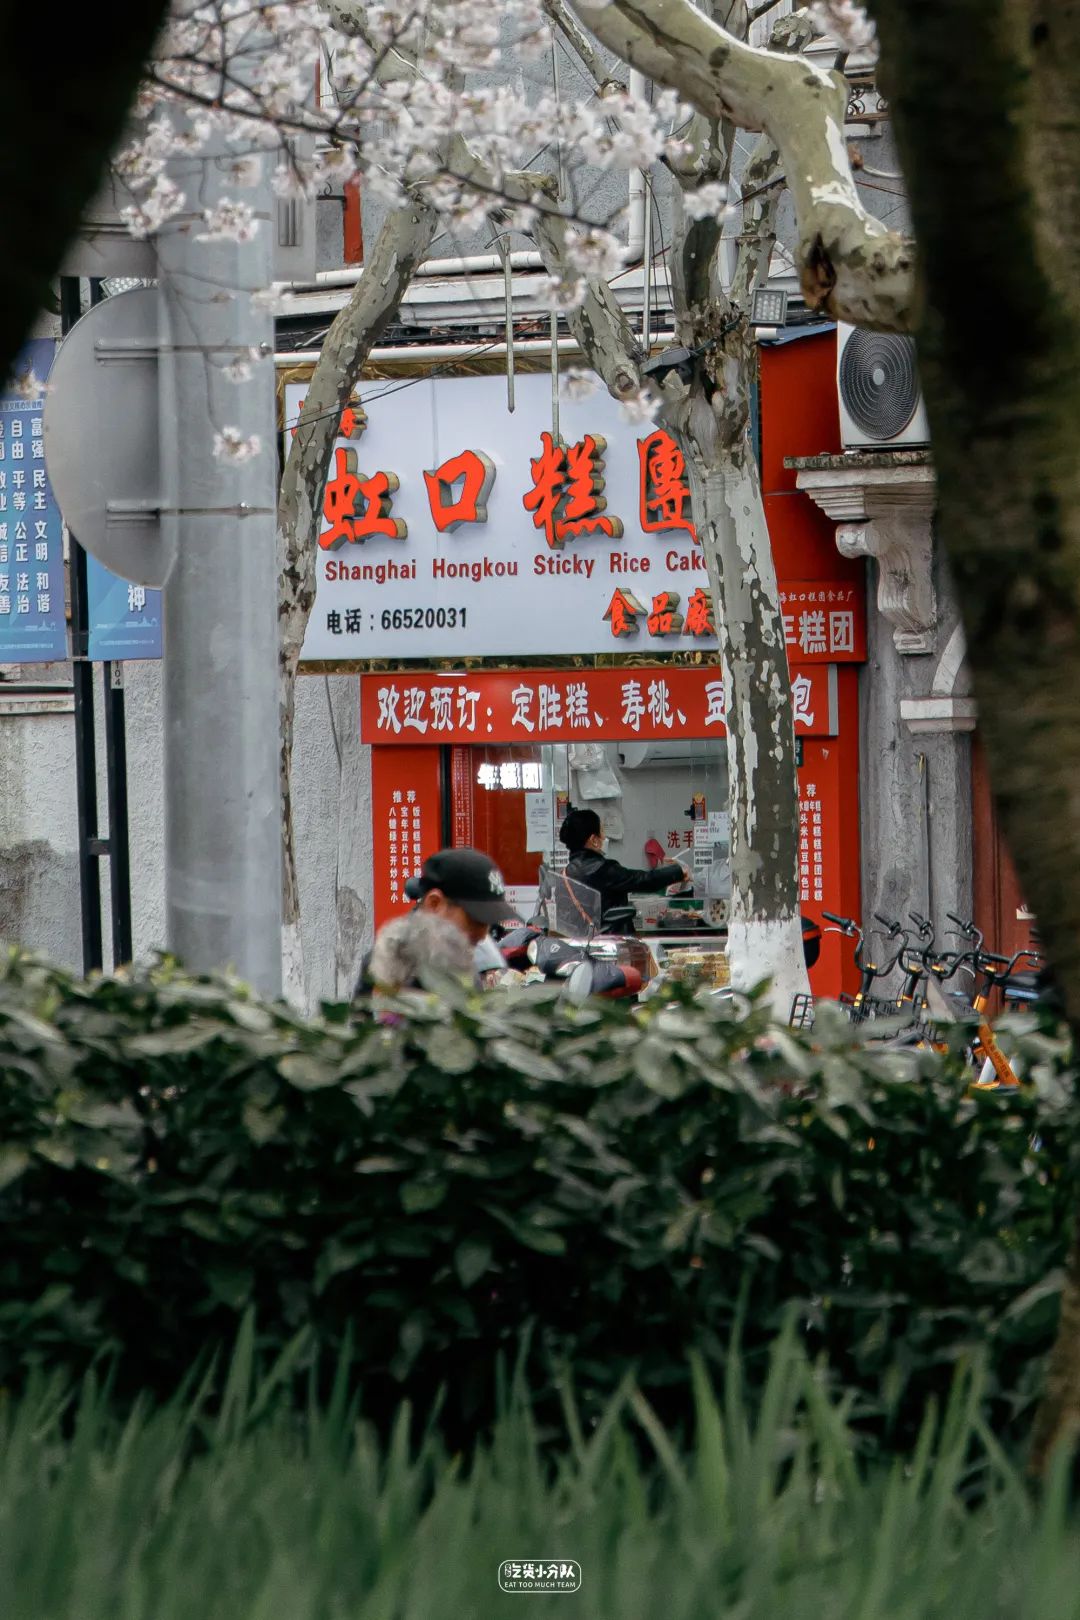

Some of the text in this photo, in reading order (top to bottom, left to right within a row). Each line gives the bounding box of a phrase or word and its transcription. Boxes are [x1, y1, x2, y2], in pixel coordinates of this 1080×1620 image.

[11, 419, 30, 613] 自由 平等 公正 法治
[31, 417, 50, 613] 富强 民主 文明 和谐
[325, 559, 417, 584] Shanghai
[432, 557, 518, 582] Hongkou
[533, 553, 595, 578] Sticky
[610, 552, 650, 573] Rice
[128, 584, 145, 611] 神
